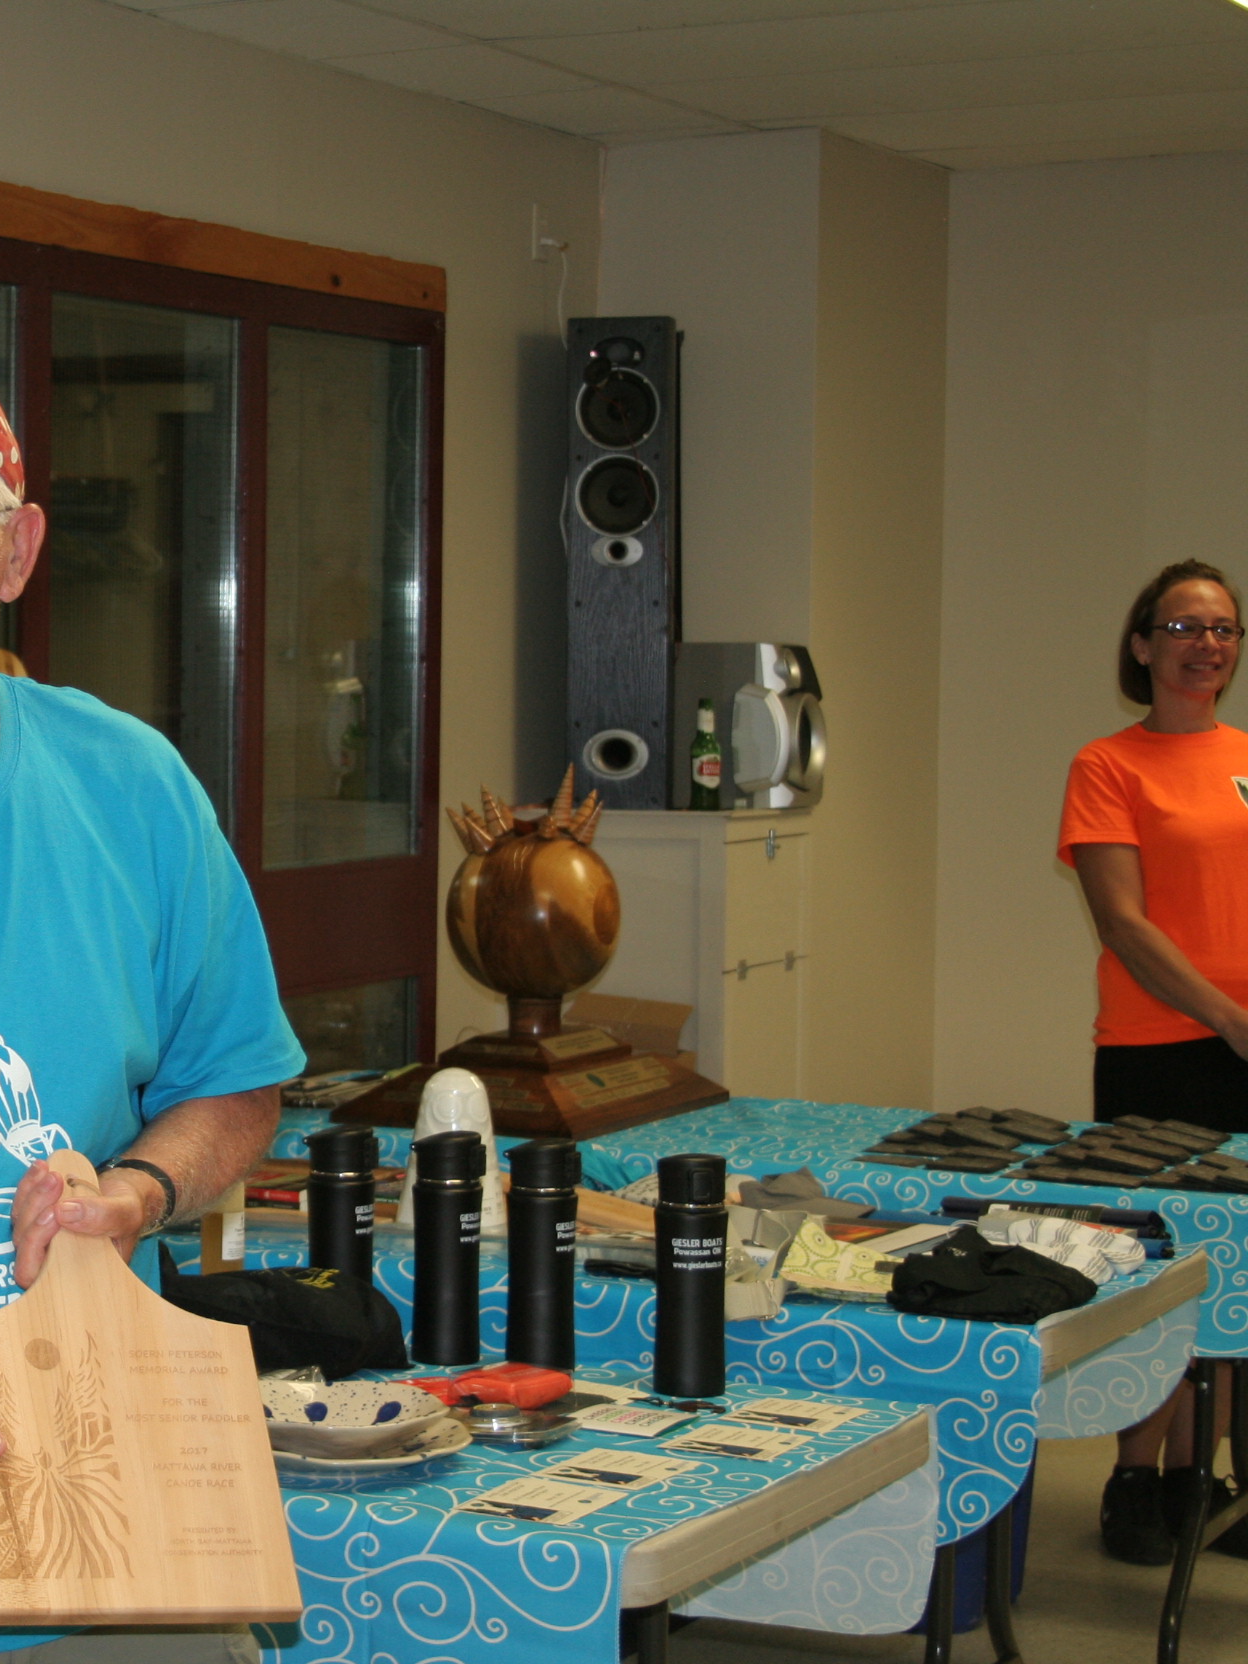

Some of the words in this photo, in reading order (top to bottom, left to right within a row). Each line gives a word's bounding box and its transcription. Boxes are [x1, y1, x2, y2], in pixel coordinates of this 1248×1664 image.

[672, 1238, 701, 1248] GIESLER
[702, 1237, 723, 1247] BOATS
[673, 1247, 711, 1256] Powassan
[168, 1350, 223, 1359] PETERSON
[129, 1366, 186, 1375] MEMORIAL
[189, 1366, 229, 1375] AWARD
[162, 1398, 183, 1407] FOR
[187, 1398, 208, 1407] THE
[125, 1414, 156, 1423] MOST
[159, 1414, 198, 1423] SENIOR
[201, 1414, 251, 1423] PADDLER
[179, 1447, 208, 1455] 2017
[153, 1462, 206, 1471] MATTAWA
[210, 1463, 242, 1471] RIVER
[166, 1479, 202, 1488] CANOE
[206, 1479, 235, 1488] RACE
